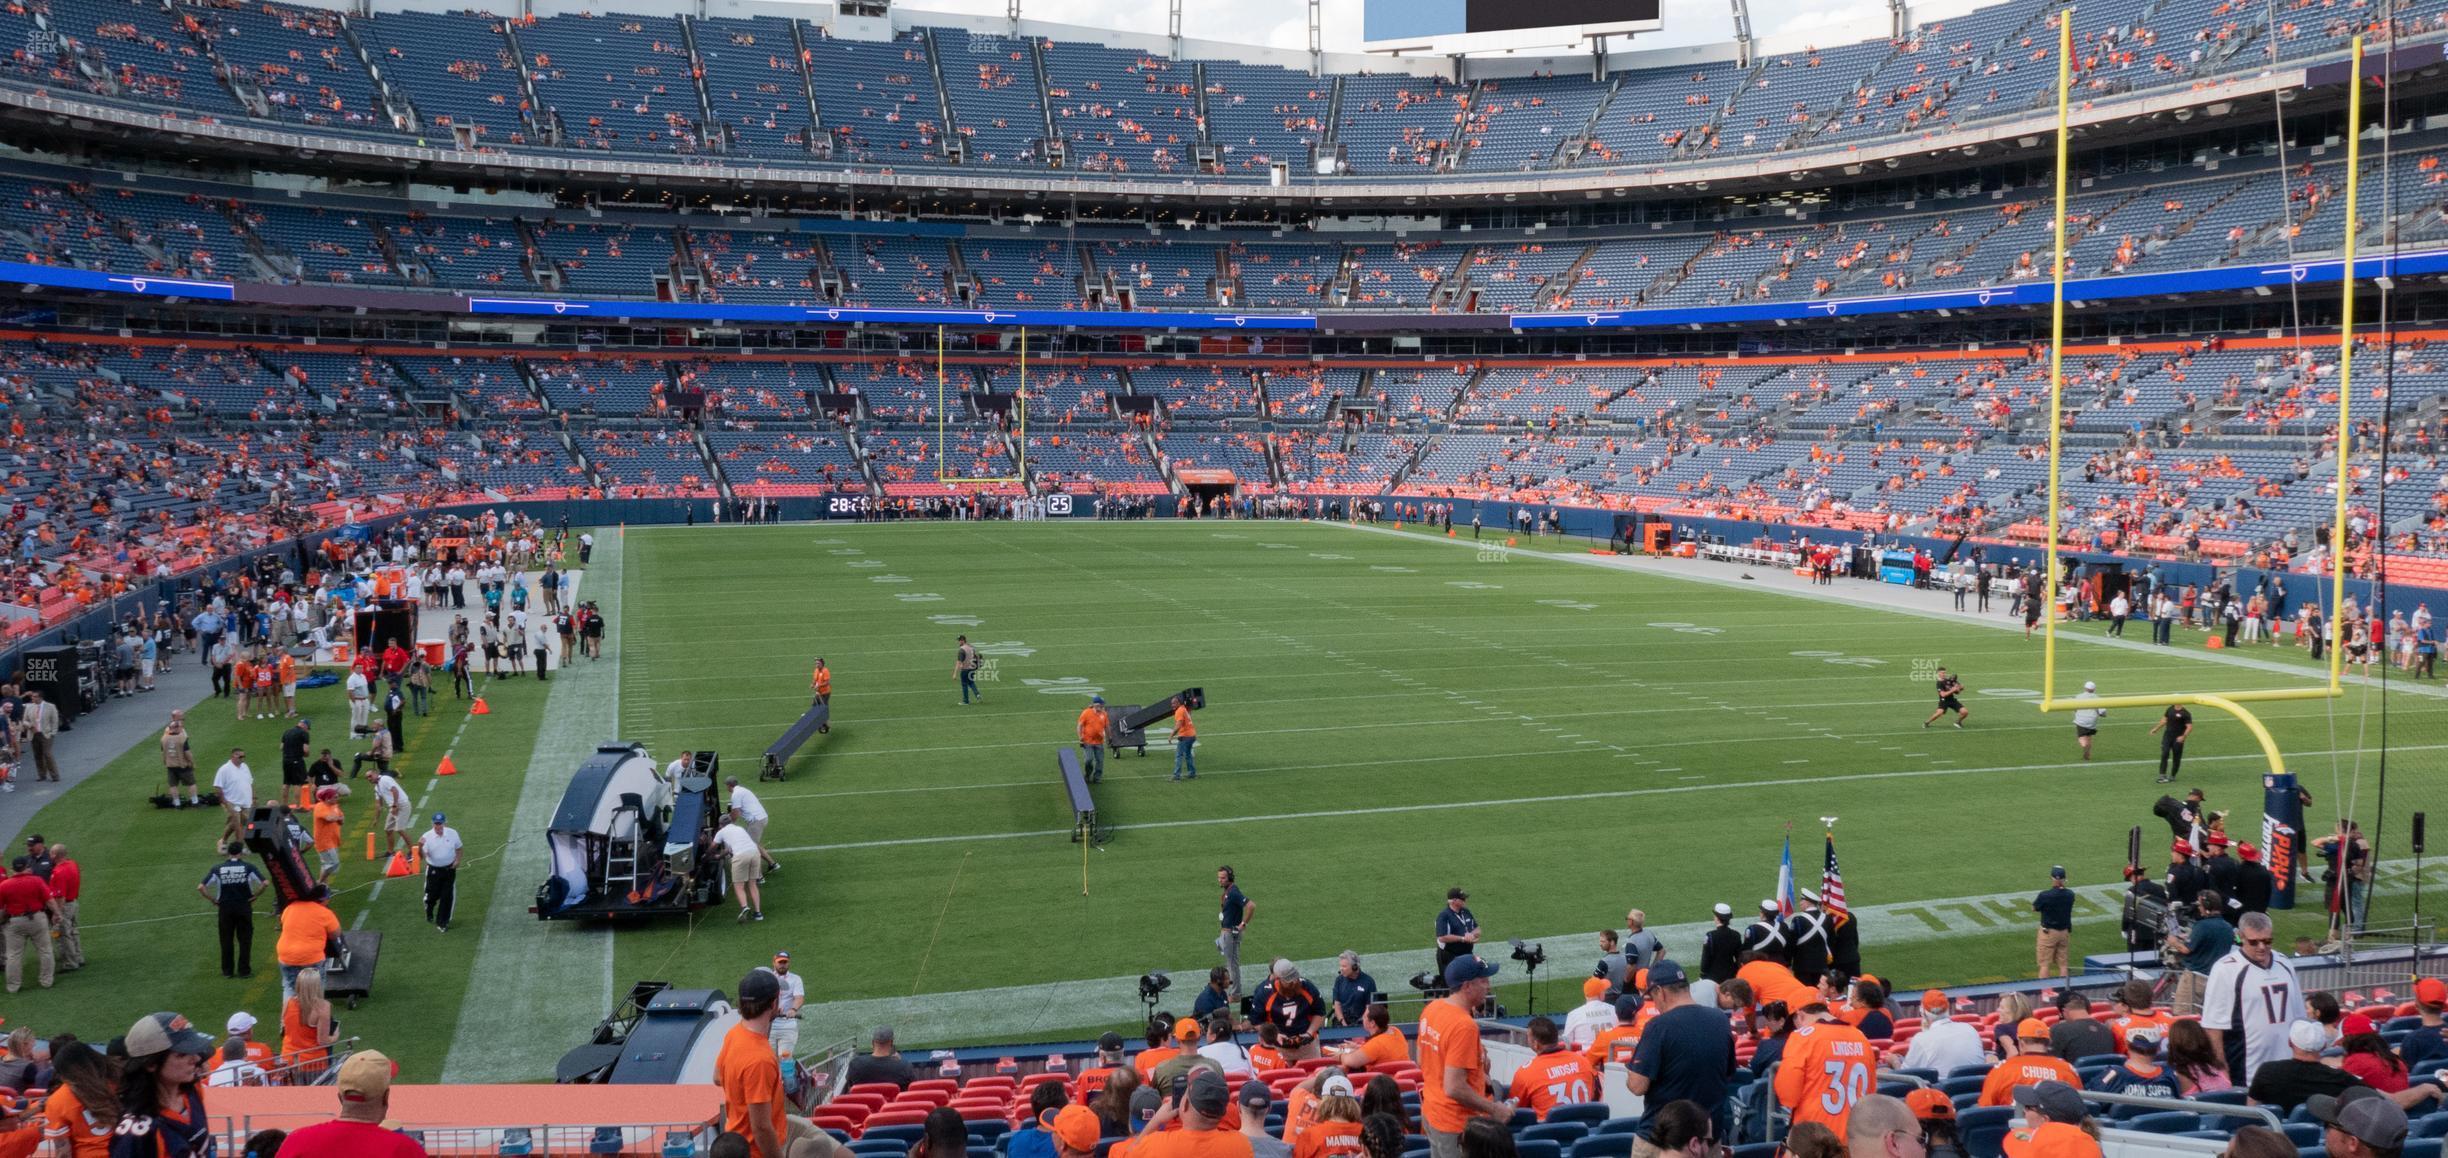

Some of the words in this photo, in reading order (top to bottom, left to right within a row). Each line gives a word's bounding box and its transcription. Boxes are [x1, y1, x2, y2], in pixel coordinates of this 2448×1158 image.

[1051, 497, 1068, 510] 25
[258, 671, 272, 681] 58
[2270, 832, 2291, 880] PLAY
[2260, 983, 2288, 1024] 17
[1282, 1004, 1297, 1026] 7
[1831, 1040, 1864, 1056] LINDSAY
[1254, 1054, 1272, 1066] MILLER
[1546, 1062, 1579, 1080] LINDSAY
[2022, 1066, 2057, 1080] CHUBB
[1548, 1078, 1588, 1105] 30
[1822, 1060, 1868, 1115] 30
[2124, 1084, 2146, 1096] JOHN
